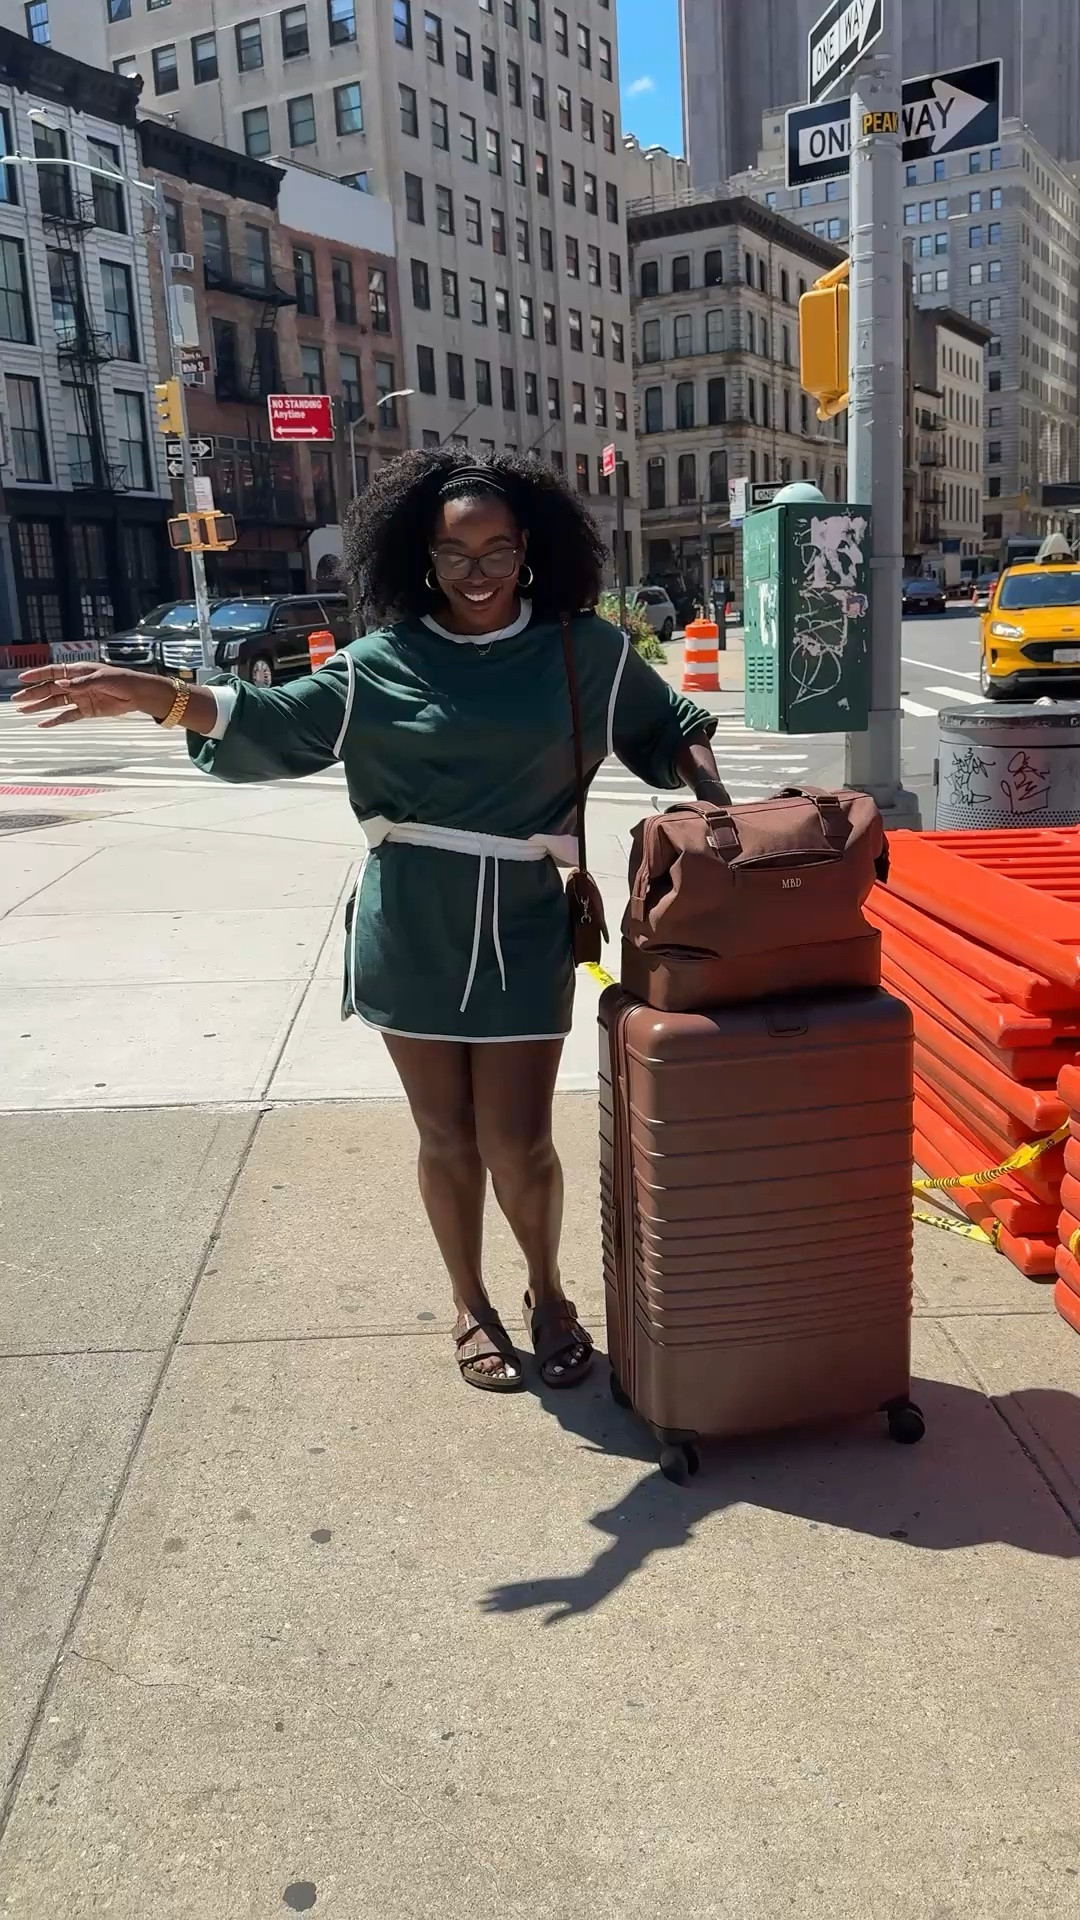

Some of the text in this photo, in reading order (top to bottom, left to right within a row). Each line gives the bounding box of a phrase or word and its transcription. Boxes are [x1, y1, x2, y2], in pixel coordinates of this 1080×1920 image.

[816, 0, 865, 76] ONE WAY
[810, 122, 851, 158] ON
[271, 399, 322, 409] NO STANDING
[273, 409, 306, 420] Anytime
[758, 489, 776, 499] ONE
[782, 878, 802, 888] MBD
